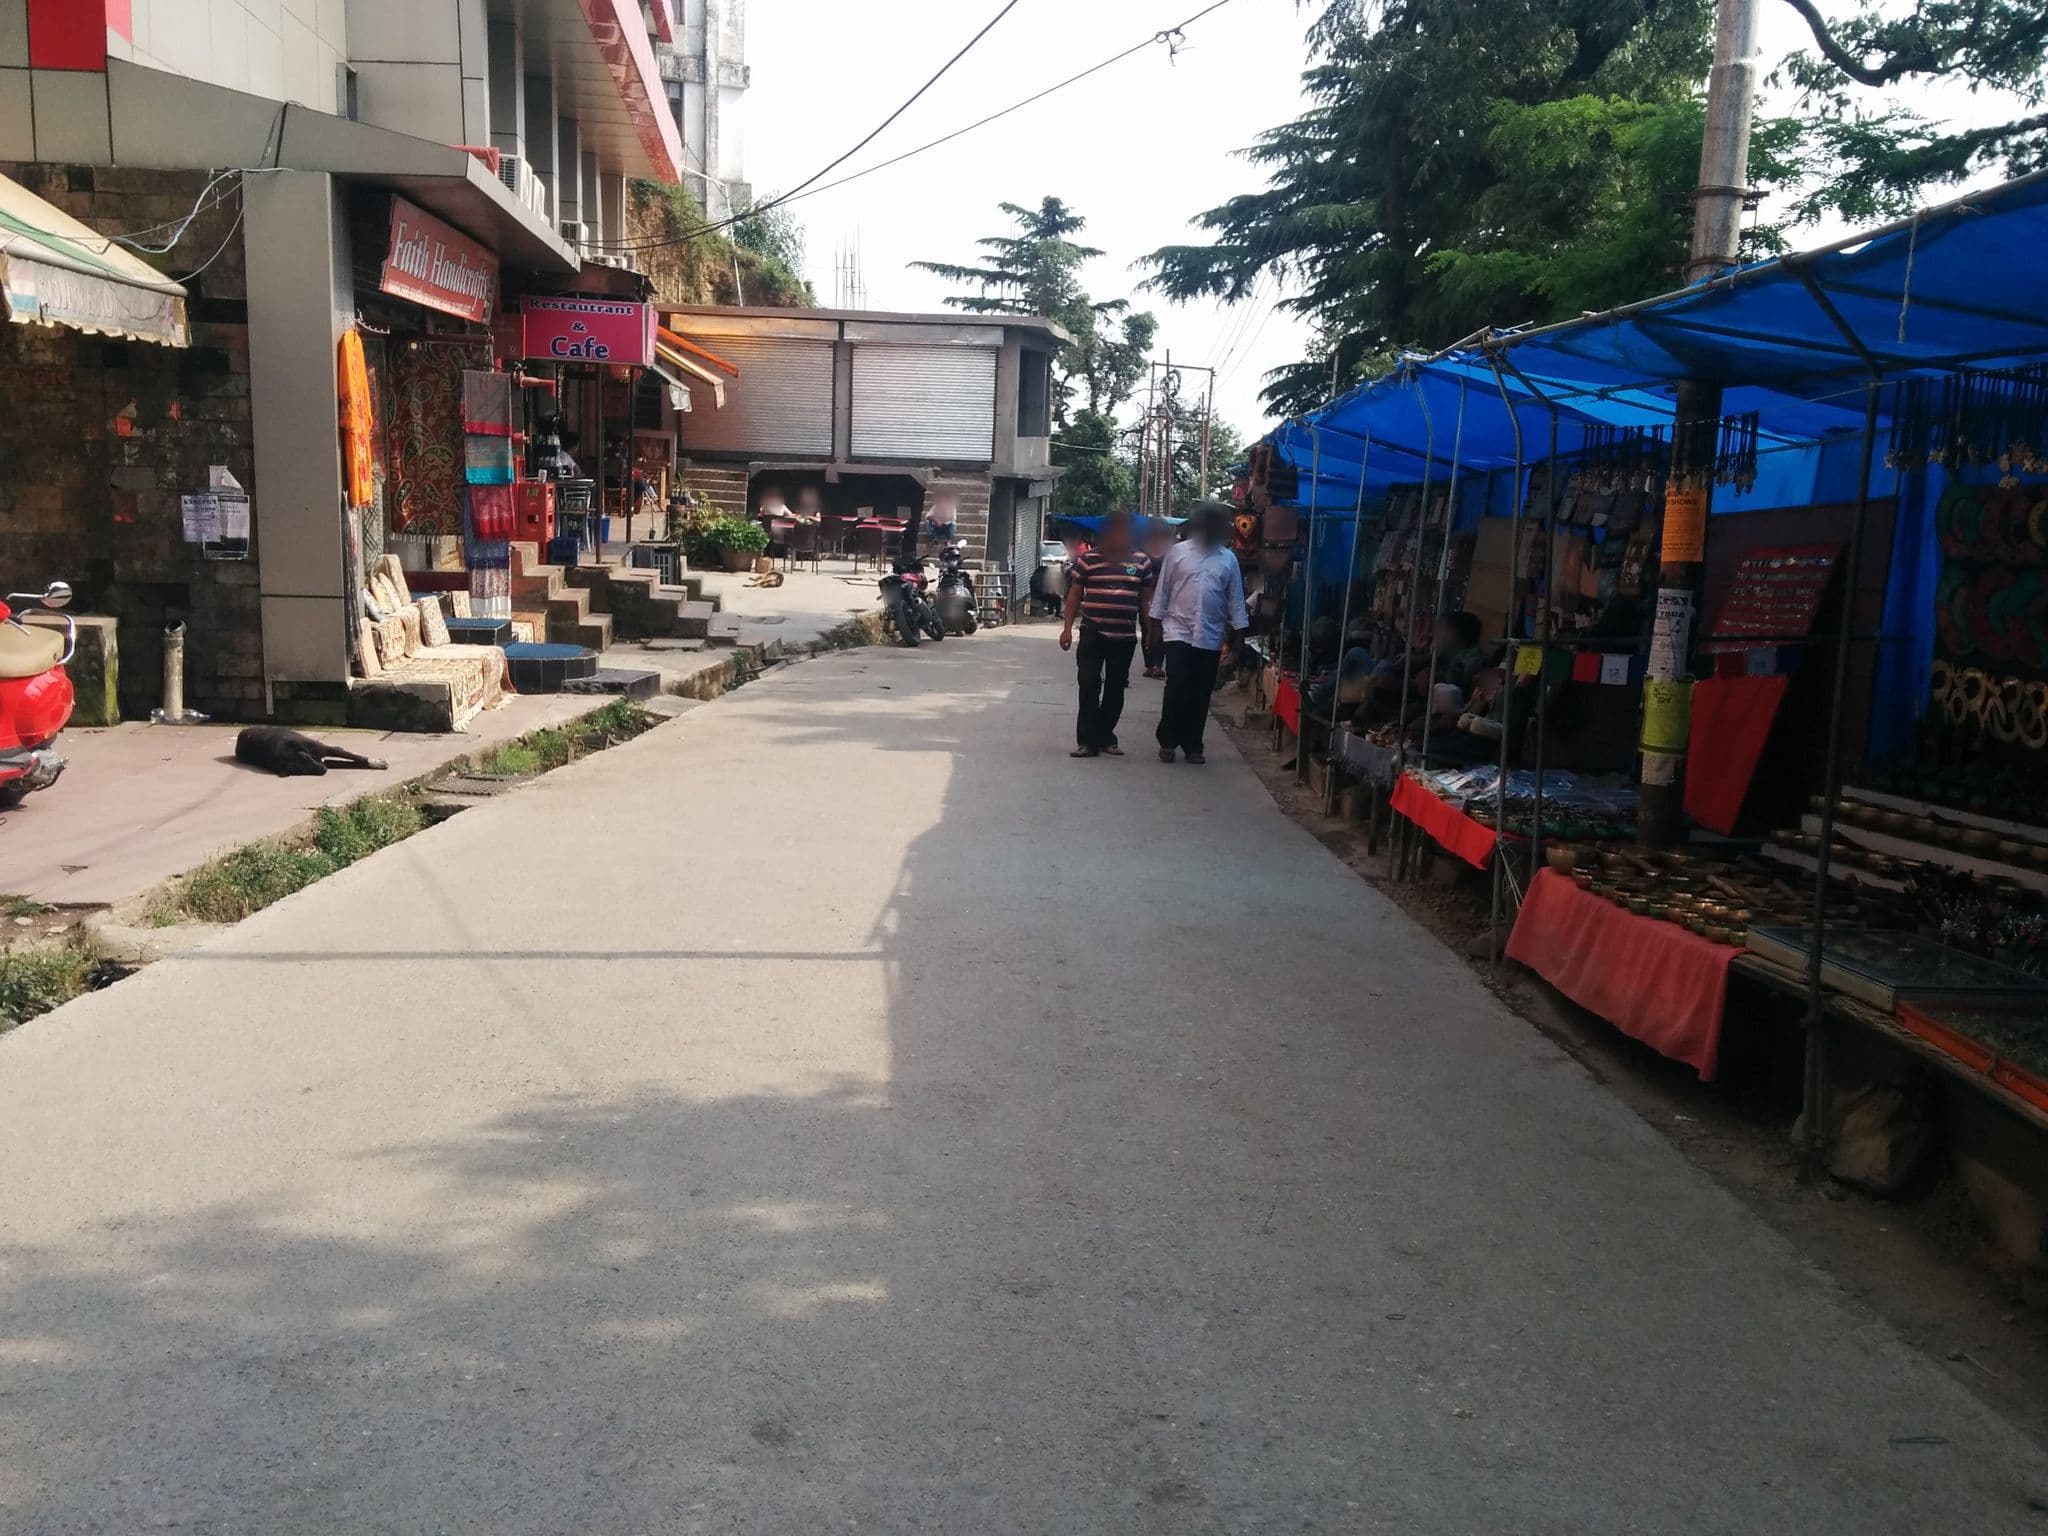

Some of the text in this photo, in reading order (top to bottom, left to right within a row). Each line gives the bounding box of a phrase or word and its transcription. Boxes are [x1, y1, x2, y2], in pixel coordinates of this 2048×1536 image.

[391, 222, 430, 280] Faith
[429, 240, 489, 312] Handicrafts
[529, 299, 634, 315] Restautrant
[570, 321, 587, 333] &
[550, 336, 610, 360] Cafe
